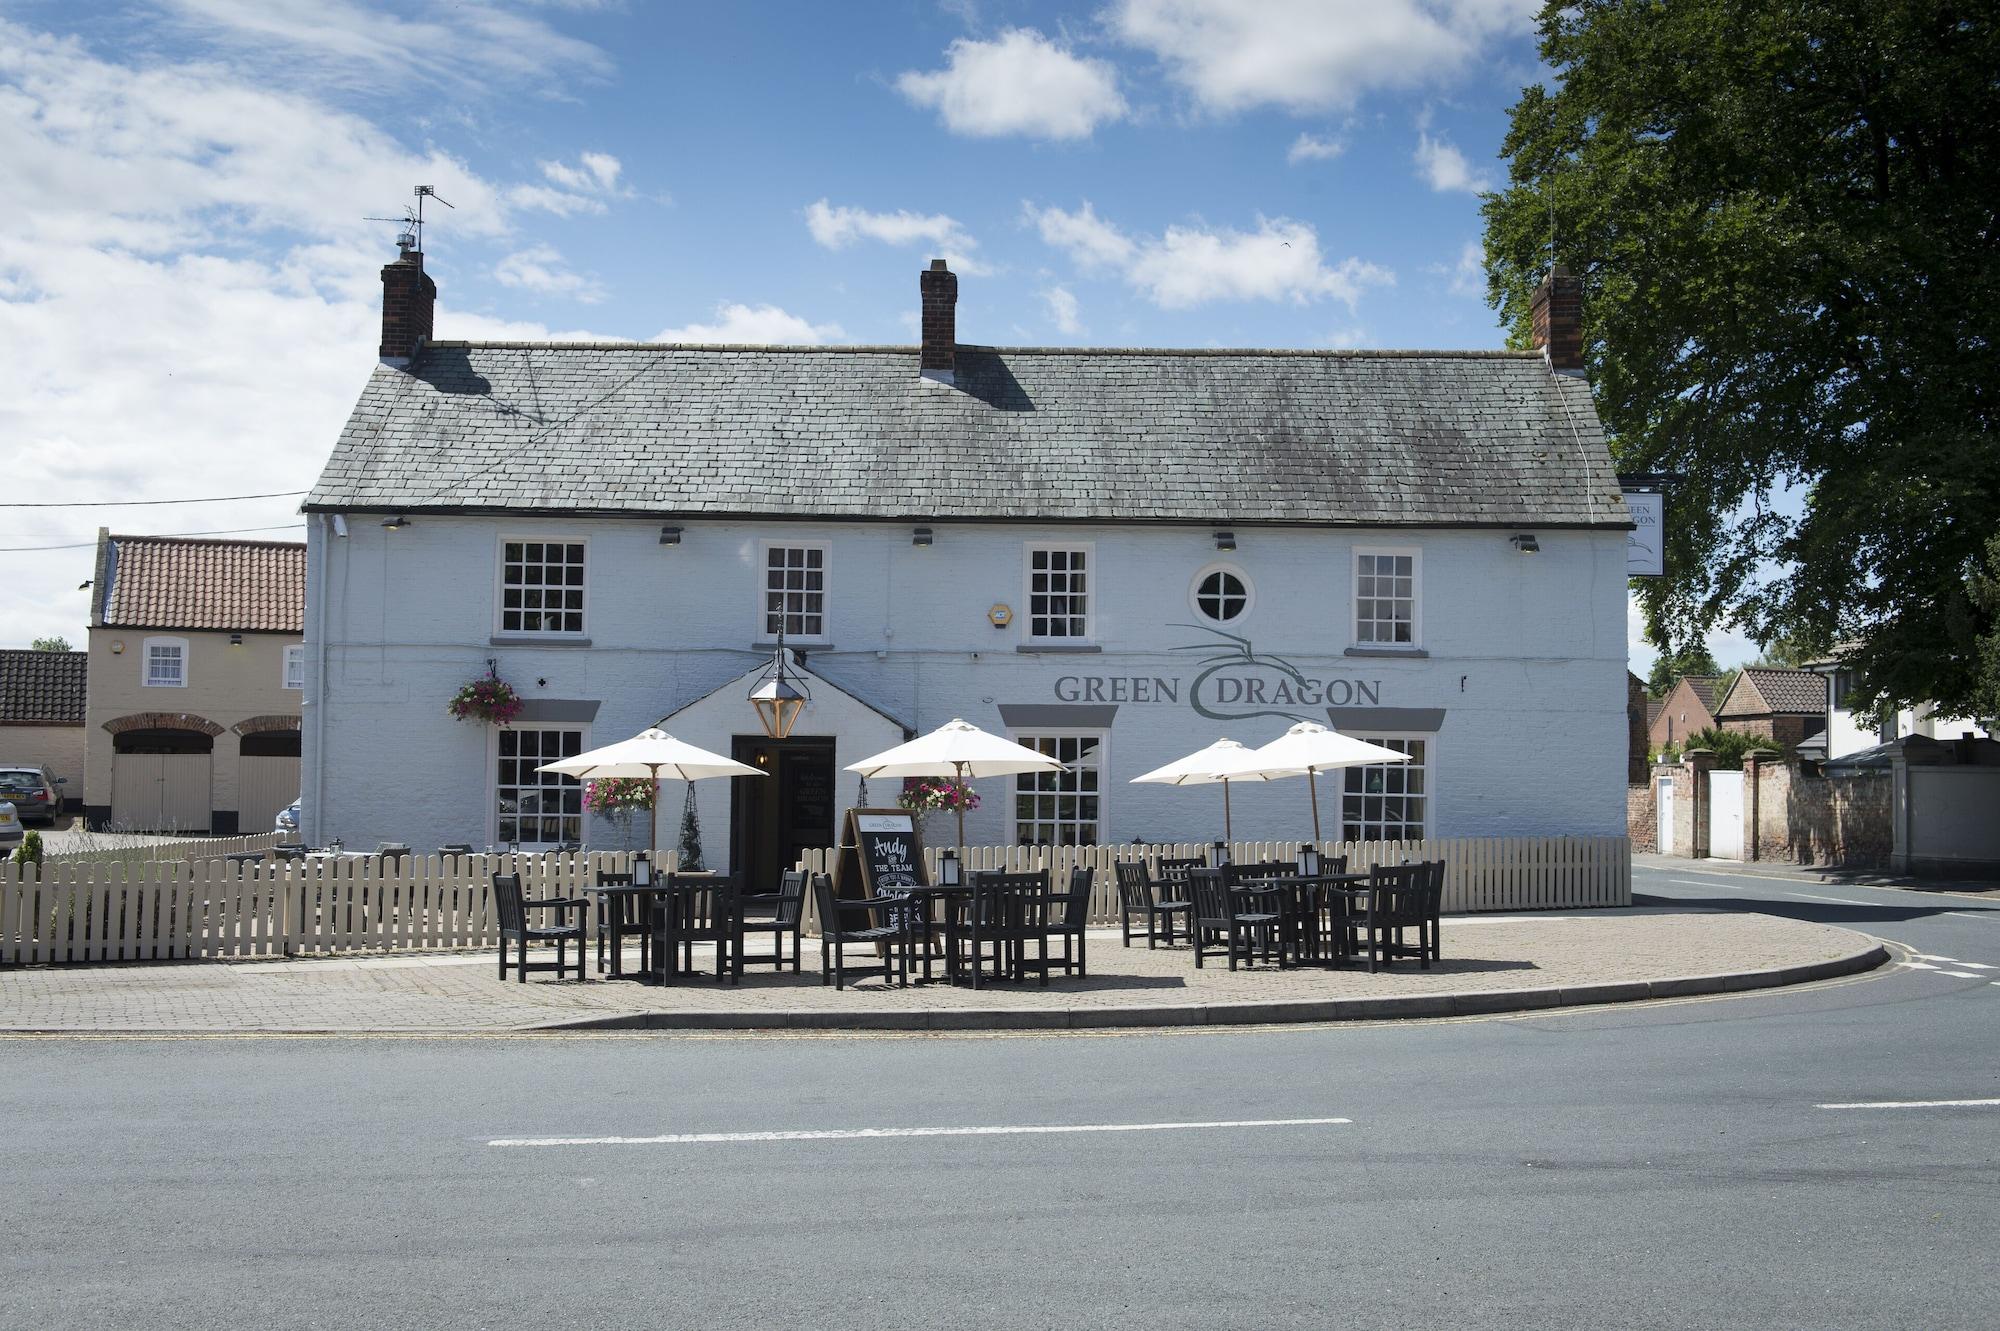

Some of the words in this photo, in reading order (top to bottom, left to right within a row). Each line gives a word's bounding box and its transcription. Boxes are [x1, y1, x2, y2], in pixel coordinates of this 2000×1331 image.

[1629, 505, 1650, 514] EEN
[1632, 516, 1656, 525] GON
[1054, 676, 1180, 704] GREEN
[1216, 677, 1383, 706] DRAGON
[874, 836, 907, 864] Andy
[874, 864, 889, 872] THE
[891, 864, 913, 872] TEAM
